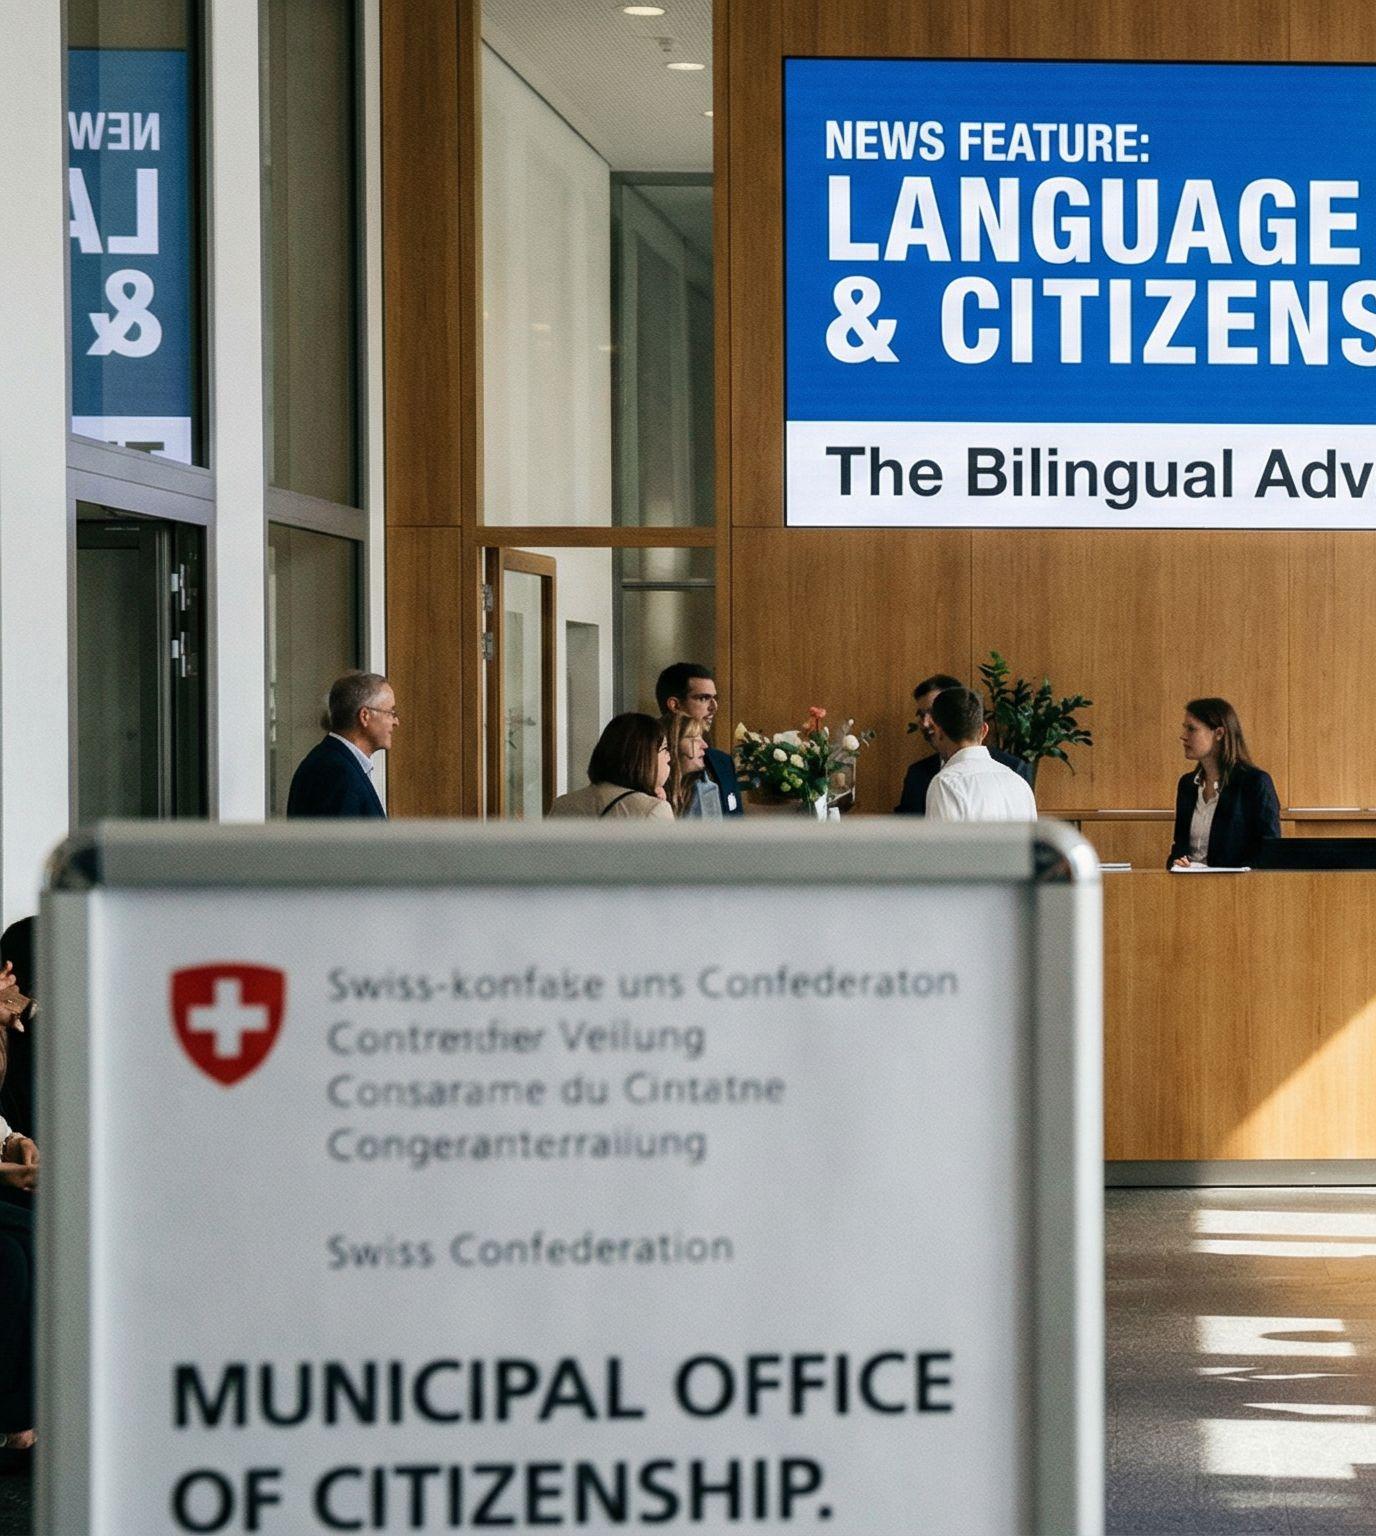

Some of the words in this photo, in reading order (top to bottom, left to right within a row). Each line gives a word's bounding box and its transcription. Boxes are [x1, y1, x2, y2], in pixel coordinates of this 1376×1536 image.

[826, 120, 944, 161] NEWS
[960, 122, 1149, 162] FEATURE:
[829, 177, 1360, 265] LANGUAGE
[826, 277, 899, 364] &
[826, 446, 943, 497] The
[967, 447, 1233, 511] Bilingual
[619, 973, 684, 998] uns
[560, 1073, 609, 1105] du
[326, 1233, 436, 1271] Swiss
[449, 1230, 734, 1267] Confederation
[173, 1357, 645, 1429] MUNICIPAL
[674, 1351, 953, 1418] OFFICE
[171, 1468, 283, 1535] OF
[313, 1457, 833, 1532] CITIZENSHIP.
